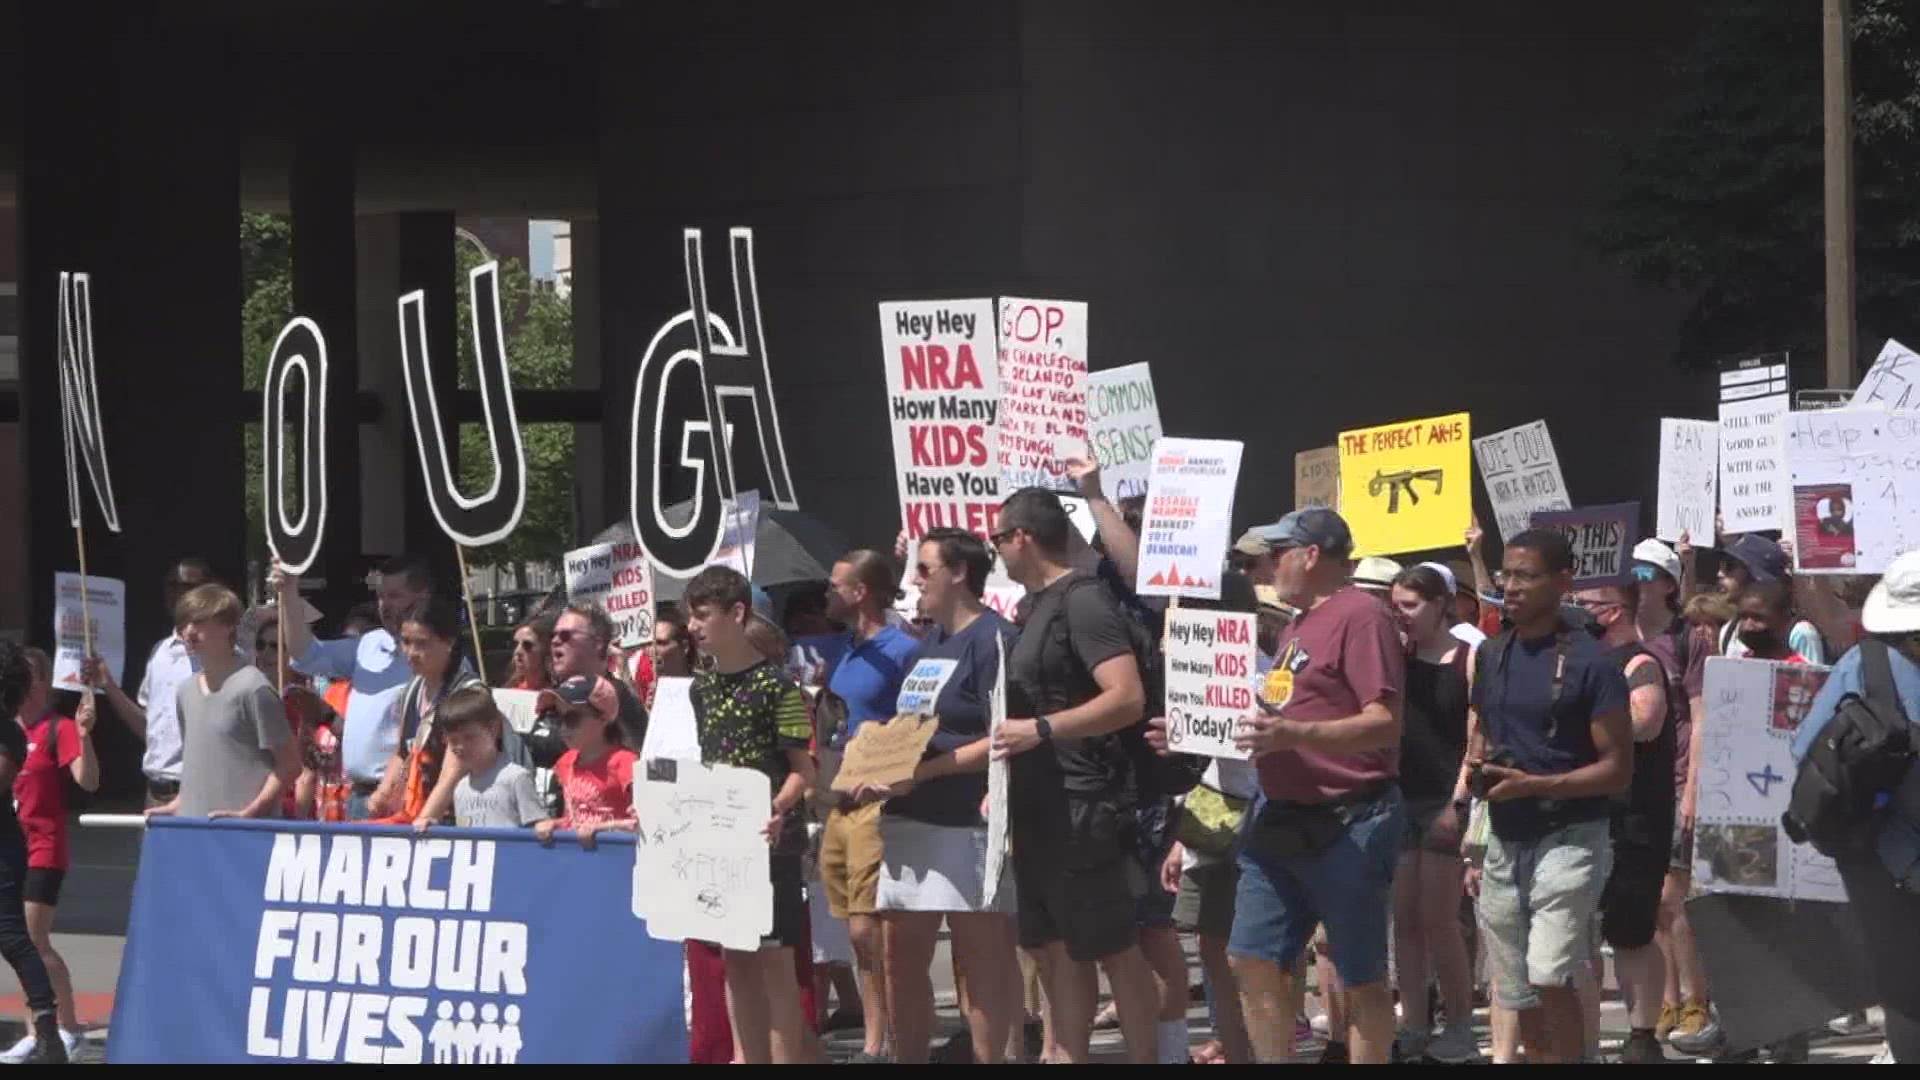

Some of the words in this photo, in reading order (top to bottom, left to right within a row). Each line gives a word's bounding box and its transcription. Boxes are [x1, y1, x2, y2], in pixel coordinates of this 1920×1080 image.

[896, 311, 932, 341] Hey
[938, 309, 976, 338] Hey
[900, 344, 984, 391] NRA
[893, 396, 935, 421] How
[939, 396, 998, 425] Many
[1088, 381, 1153, 422] COMMON
[909, 424, 989, 467] KIDS
[1344, 434, 1368, 456] THE
[1372, 425, 1422, 452] PERFECT
[1513, 423, 1551, 465] OUT
[1726, 438, 1754, 451] GOOD
[905, 471, 955, 496] Have
[957, 471, 998, 495] You
[1755, 480, 1772, 494] THE
[1584, 520, 1618, 551] THIS
[569, 558, 588, 574] Hey
[611, 543, 643, 564] NRA
[612, 566, 642, 588] KIDS
[606, 590, 648, 612] KILLED
[1170, 621, 1190, 645] Hey
[1192, 622, 1215, 647] Hey
[1216, 618, 1249, 644] NRA
[1215, 653, 1247, 677] KIDS
[1205, 684, 1250, 710] KILLED
[1184, 713, 1233, 744] Today?
[1747, 765, 1783, 796] 4
[264, 834, 496, 912] MARCH
[255, 910, 383, 986] FOR
[389, 916, 528, 995] OUR
[247, 986, 429, 1064] LIVES
